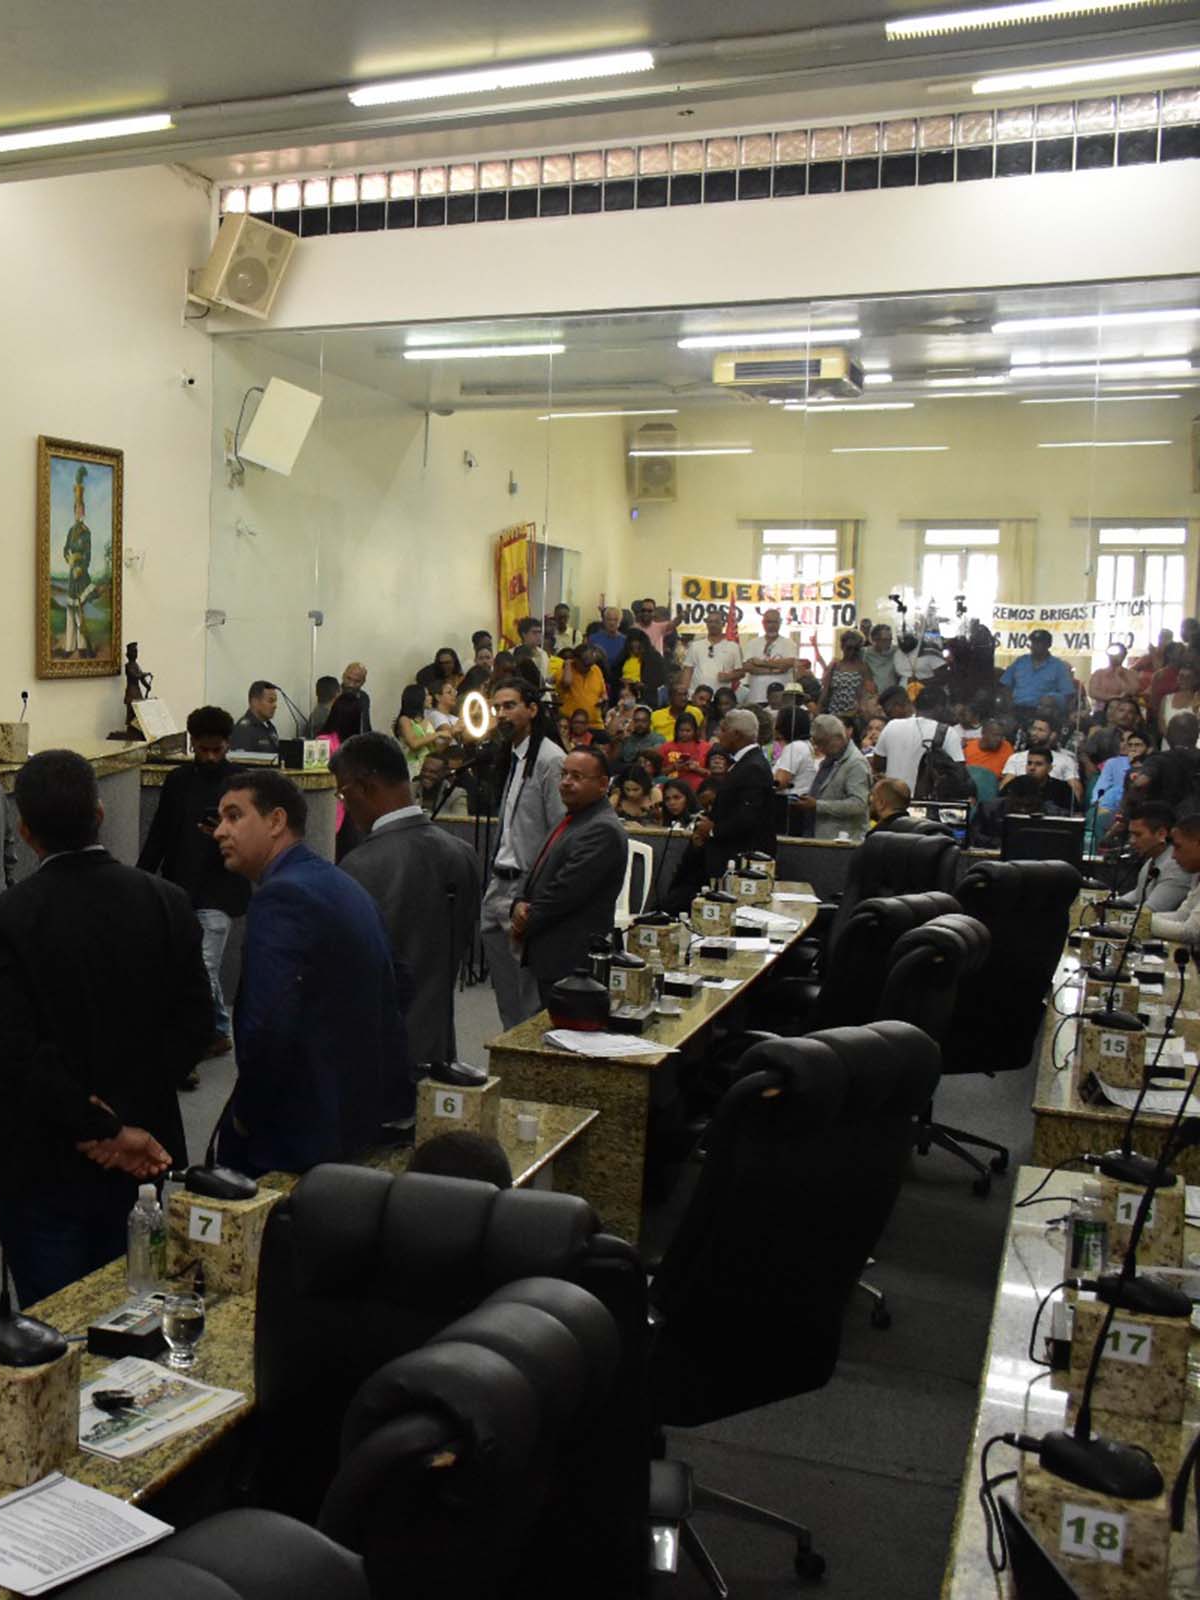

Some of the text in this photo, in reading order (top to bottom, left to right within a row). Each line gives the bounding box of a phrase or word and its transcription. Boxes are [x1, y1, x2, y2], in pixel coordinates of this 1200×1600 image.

[684, 576, 852, 601] QUEREMOS
[1039, 606, 1088, 621] BRIGAS
[743, 882, 753, 893] 2
[706, 907, 715, 918] 3
[642, 932, 652, 942] 4
[612, 974, 621, 987] 5
[1103, 1040, 1126, 1053] 15
[443, 1097, 456, 1114] 6
[198, 1215, 213, 1236] 7
[1104, 1329, 1148, 1356] 17
[1066, 1515, 1119, 1550] 18
